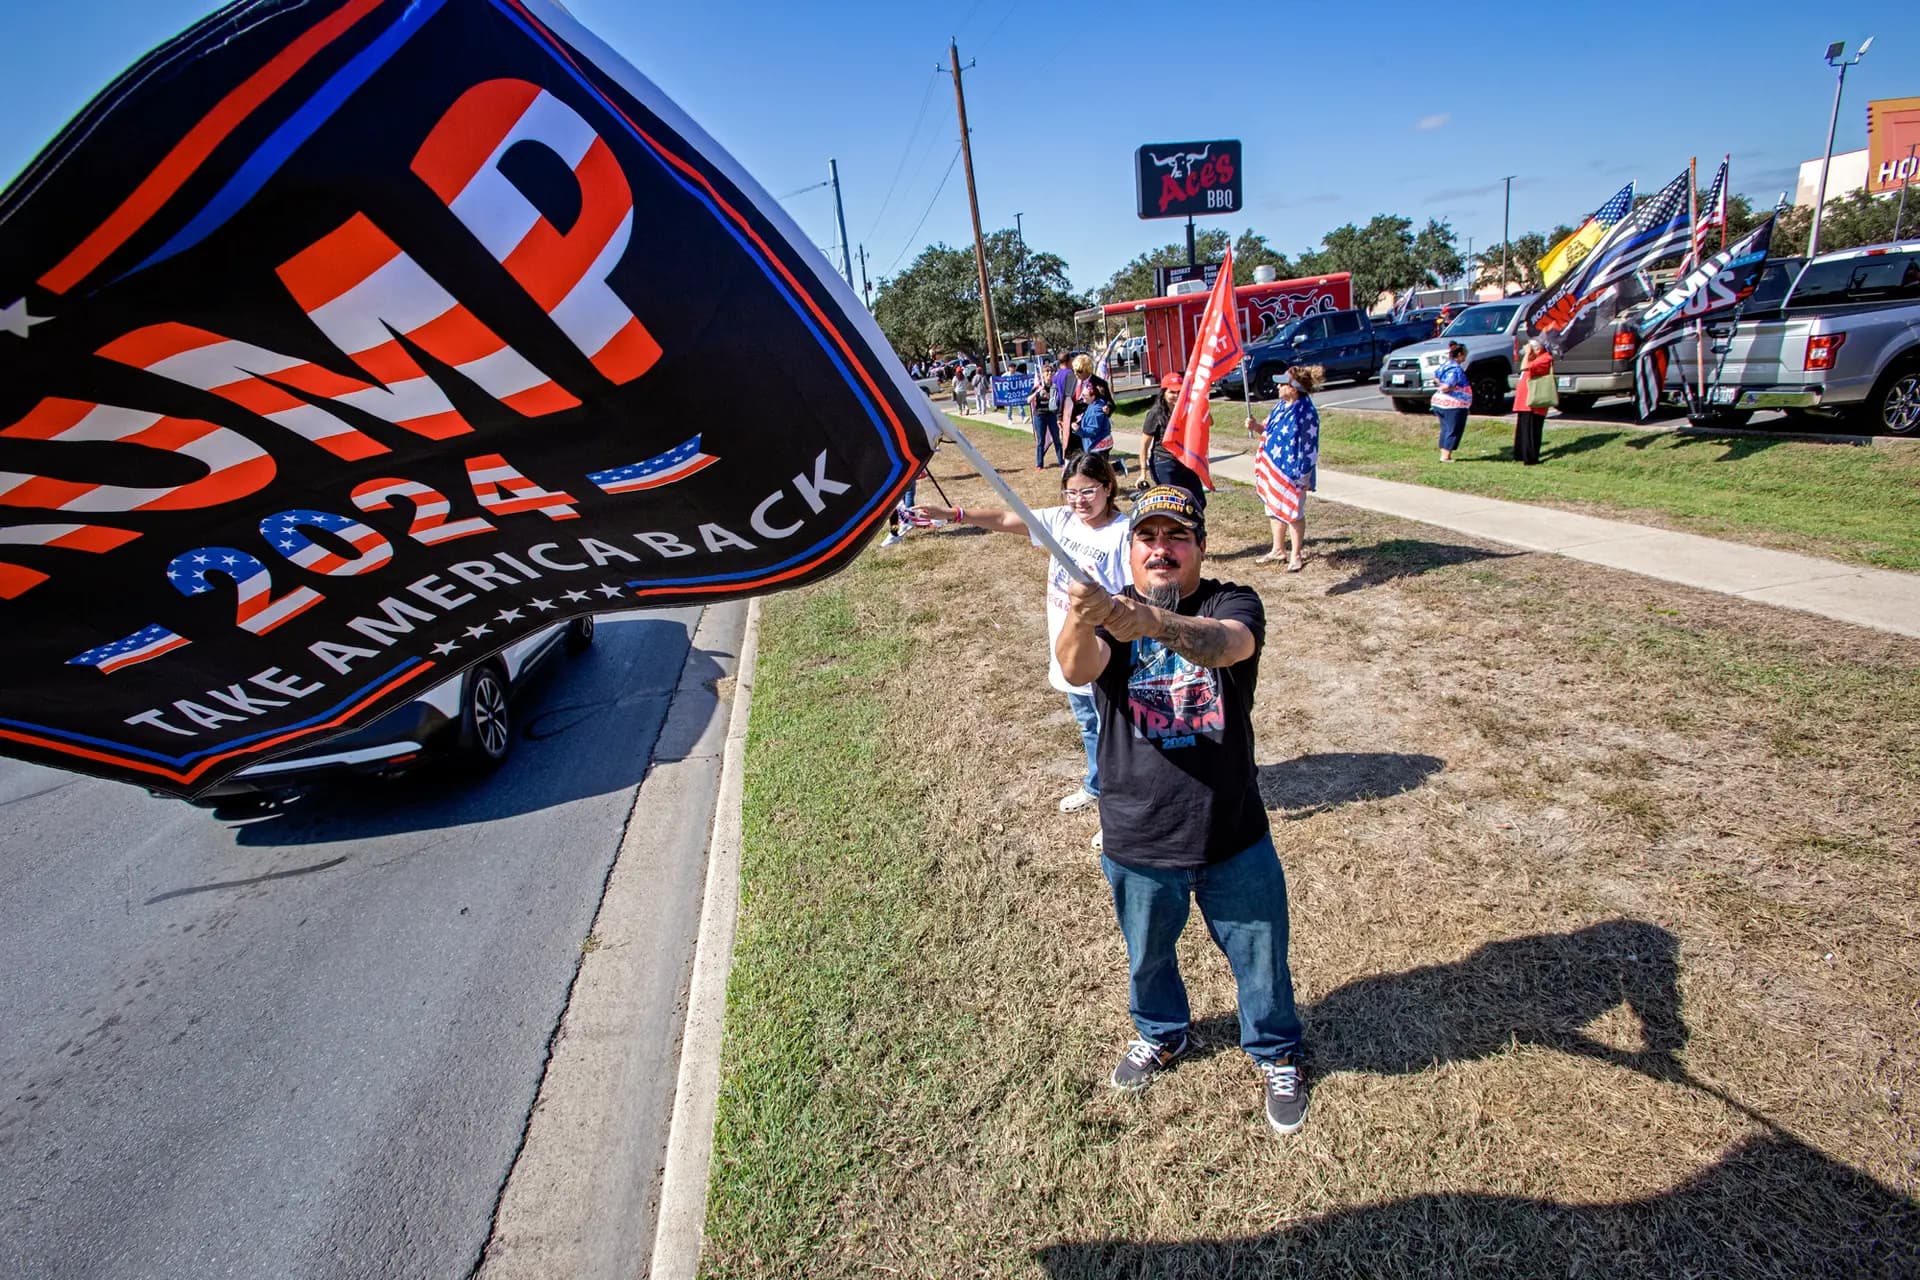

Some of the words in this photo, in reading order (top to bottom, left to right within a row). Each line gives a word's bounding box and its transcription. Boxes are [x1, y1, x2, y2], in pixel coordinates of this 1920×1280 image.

[1158, 153, 1235, 213] Ace's
[1877, 156, 1920, 184] HO
[1206, 188, 1234, 209] BBQ
[994, 378, 1034, 391] TRUMP
[1140, 502, 1184, 515] VETERAN
[166, 453, 580, 636] 2024
[124, 666, 324, 736] TAKE
[308, 535, 629, 676] AMERICA
[636, 448, 851, 558] BACK
[1128, 694, 1225, 739] TRAIN
[1161, 735, 1196, 750] 2024
